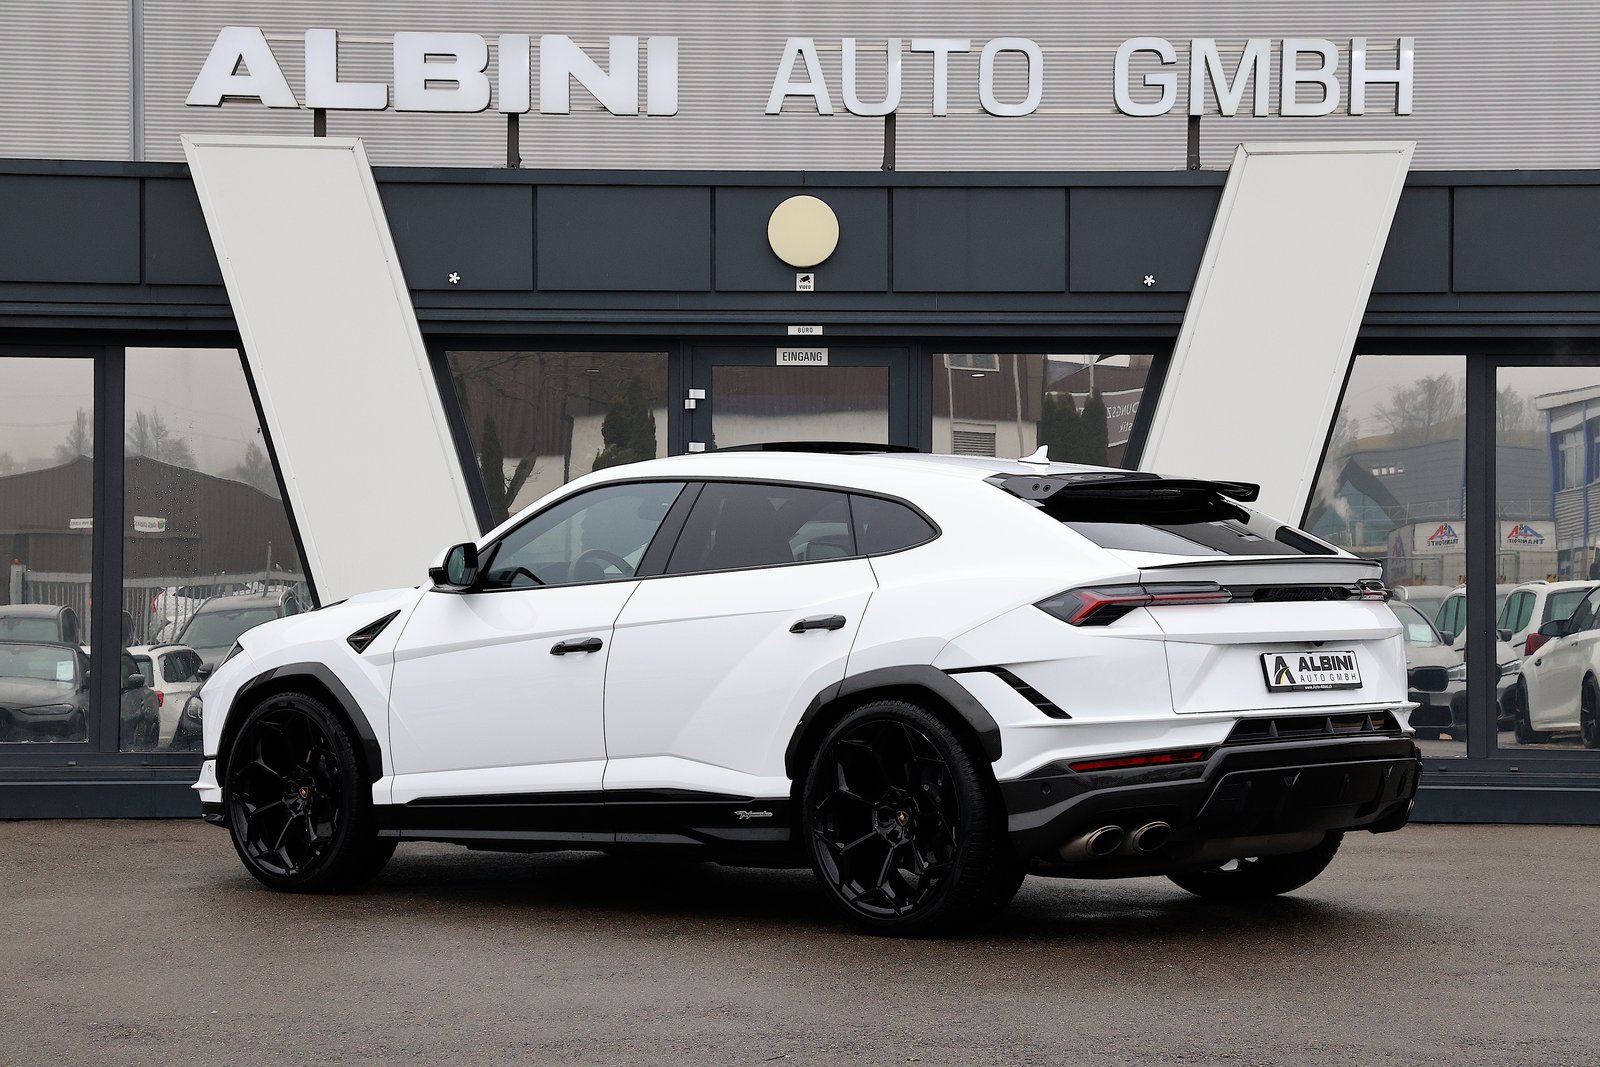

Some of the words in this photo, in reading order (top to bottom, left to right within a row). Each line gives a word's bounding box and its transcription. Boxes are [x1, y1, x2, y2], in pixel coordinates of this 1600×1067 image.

[186, 26, 679, 116] ALBINI
[765, 37, 1044, 116] AUTO
[1114, 37, 1415, 116] GMBH
[782, 351, 823, 362] EINGANG
[1299, 655, 1354, 672] ALBINI
[1300, 673, 1326, 683] AUTO
[1329, 673, 1356, 682] GMBH
